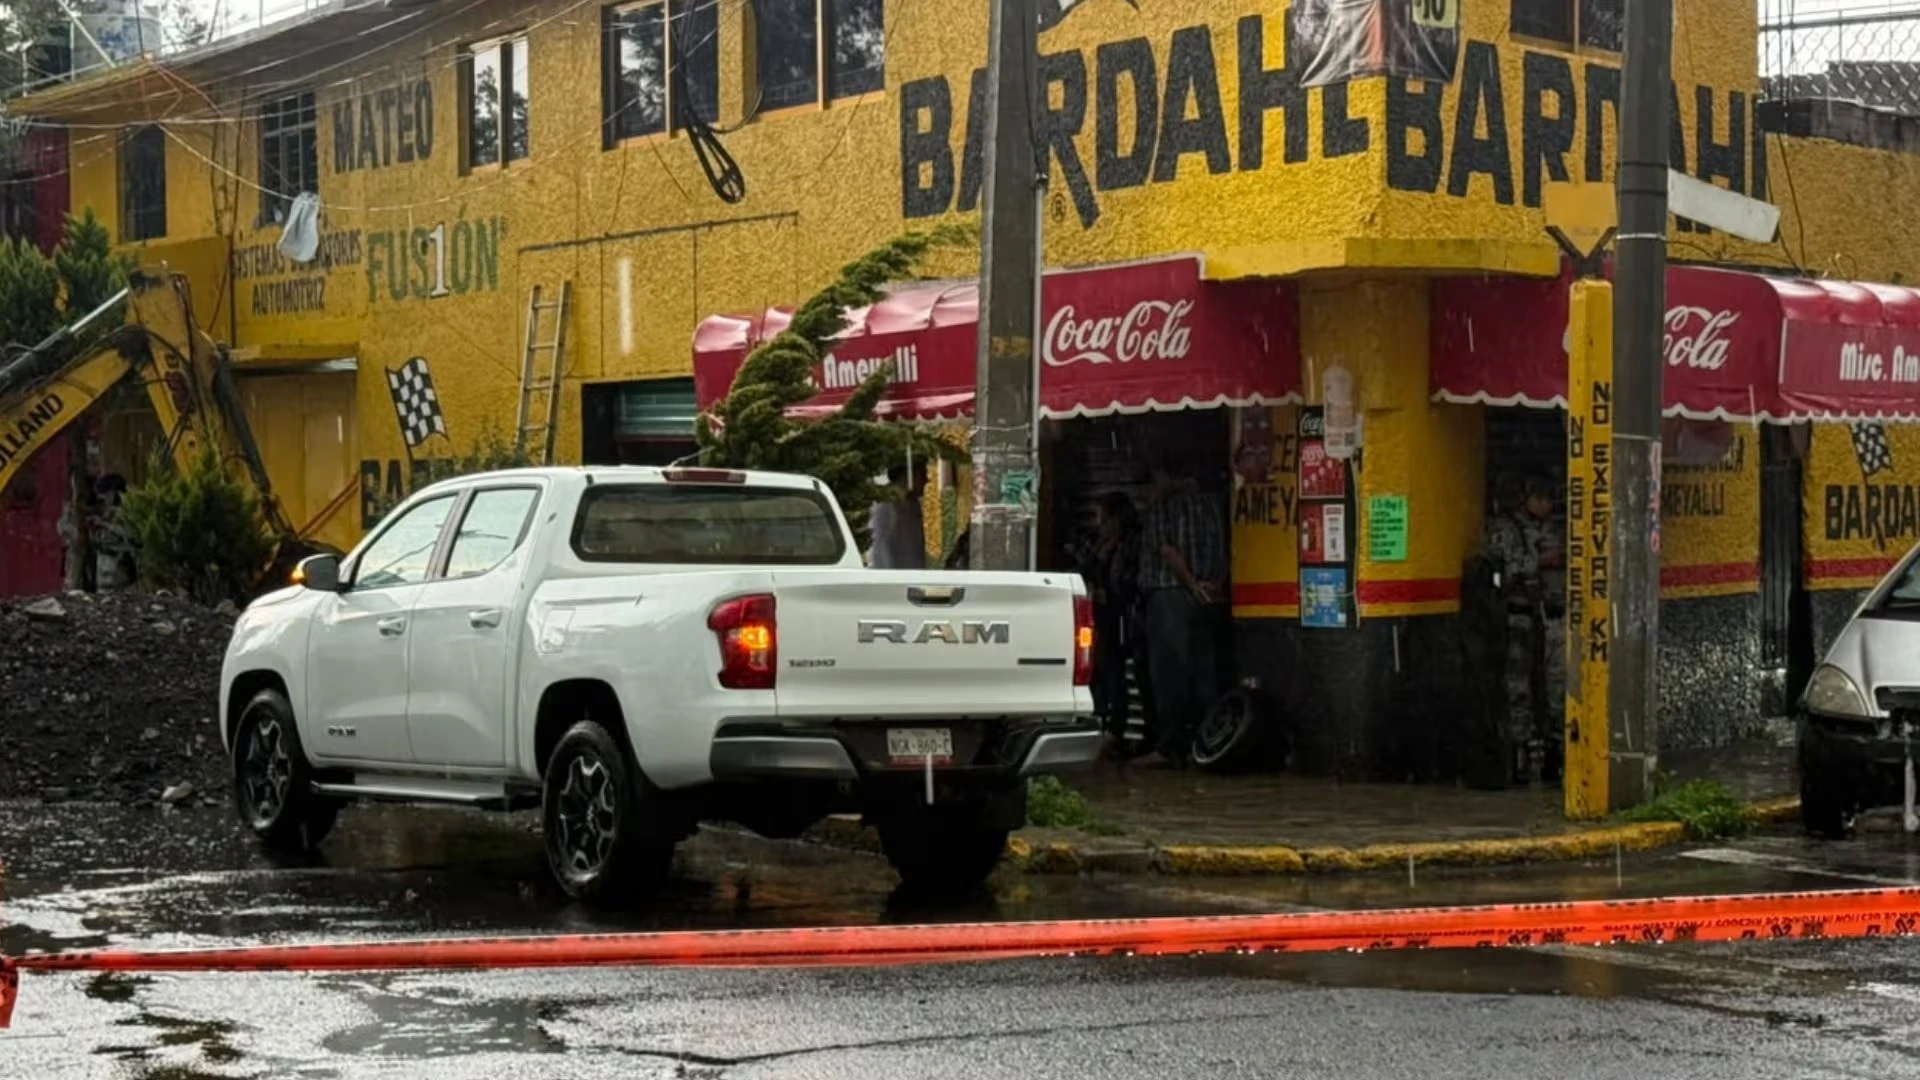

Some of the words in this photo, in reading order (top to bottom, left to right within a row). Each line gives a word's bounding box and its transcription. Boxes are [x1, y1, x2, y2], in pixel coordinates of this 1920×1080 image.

[333, 80, 433, 174] MATEO
[252, 276, 324, 314] AUTOMOTRIZ
[1043, 299, 1195, 366] Coca-Cola
[824, 344, 919, 389] Amelli
[1840, 341, 1888, 381] Misc.
[1592, 381, 1610, 425] NO
[1570, 416, 1585, 459] NO
[1825, 484, 1920, 553] BARDA
[857, 620, 1010, 644] RAM
[1590, 618, 1608, 662] KM
